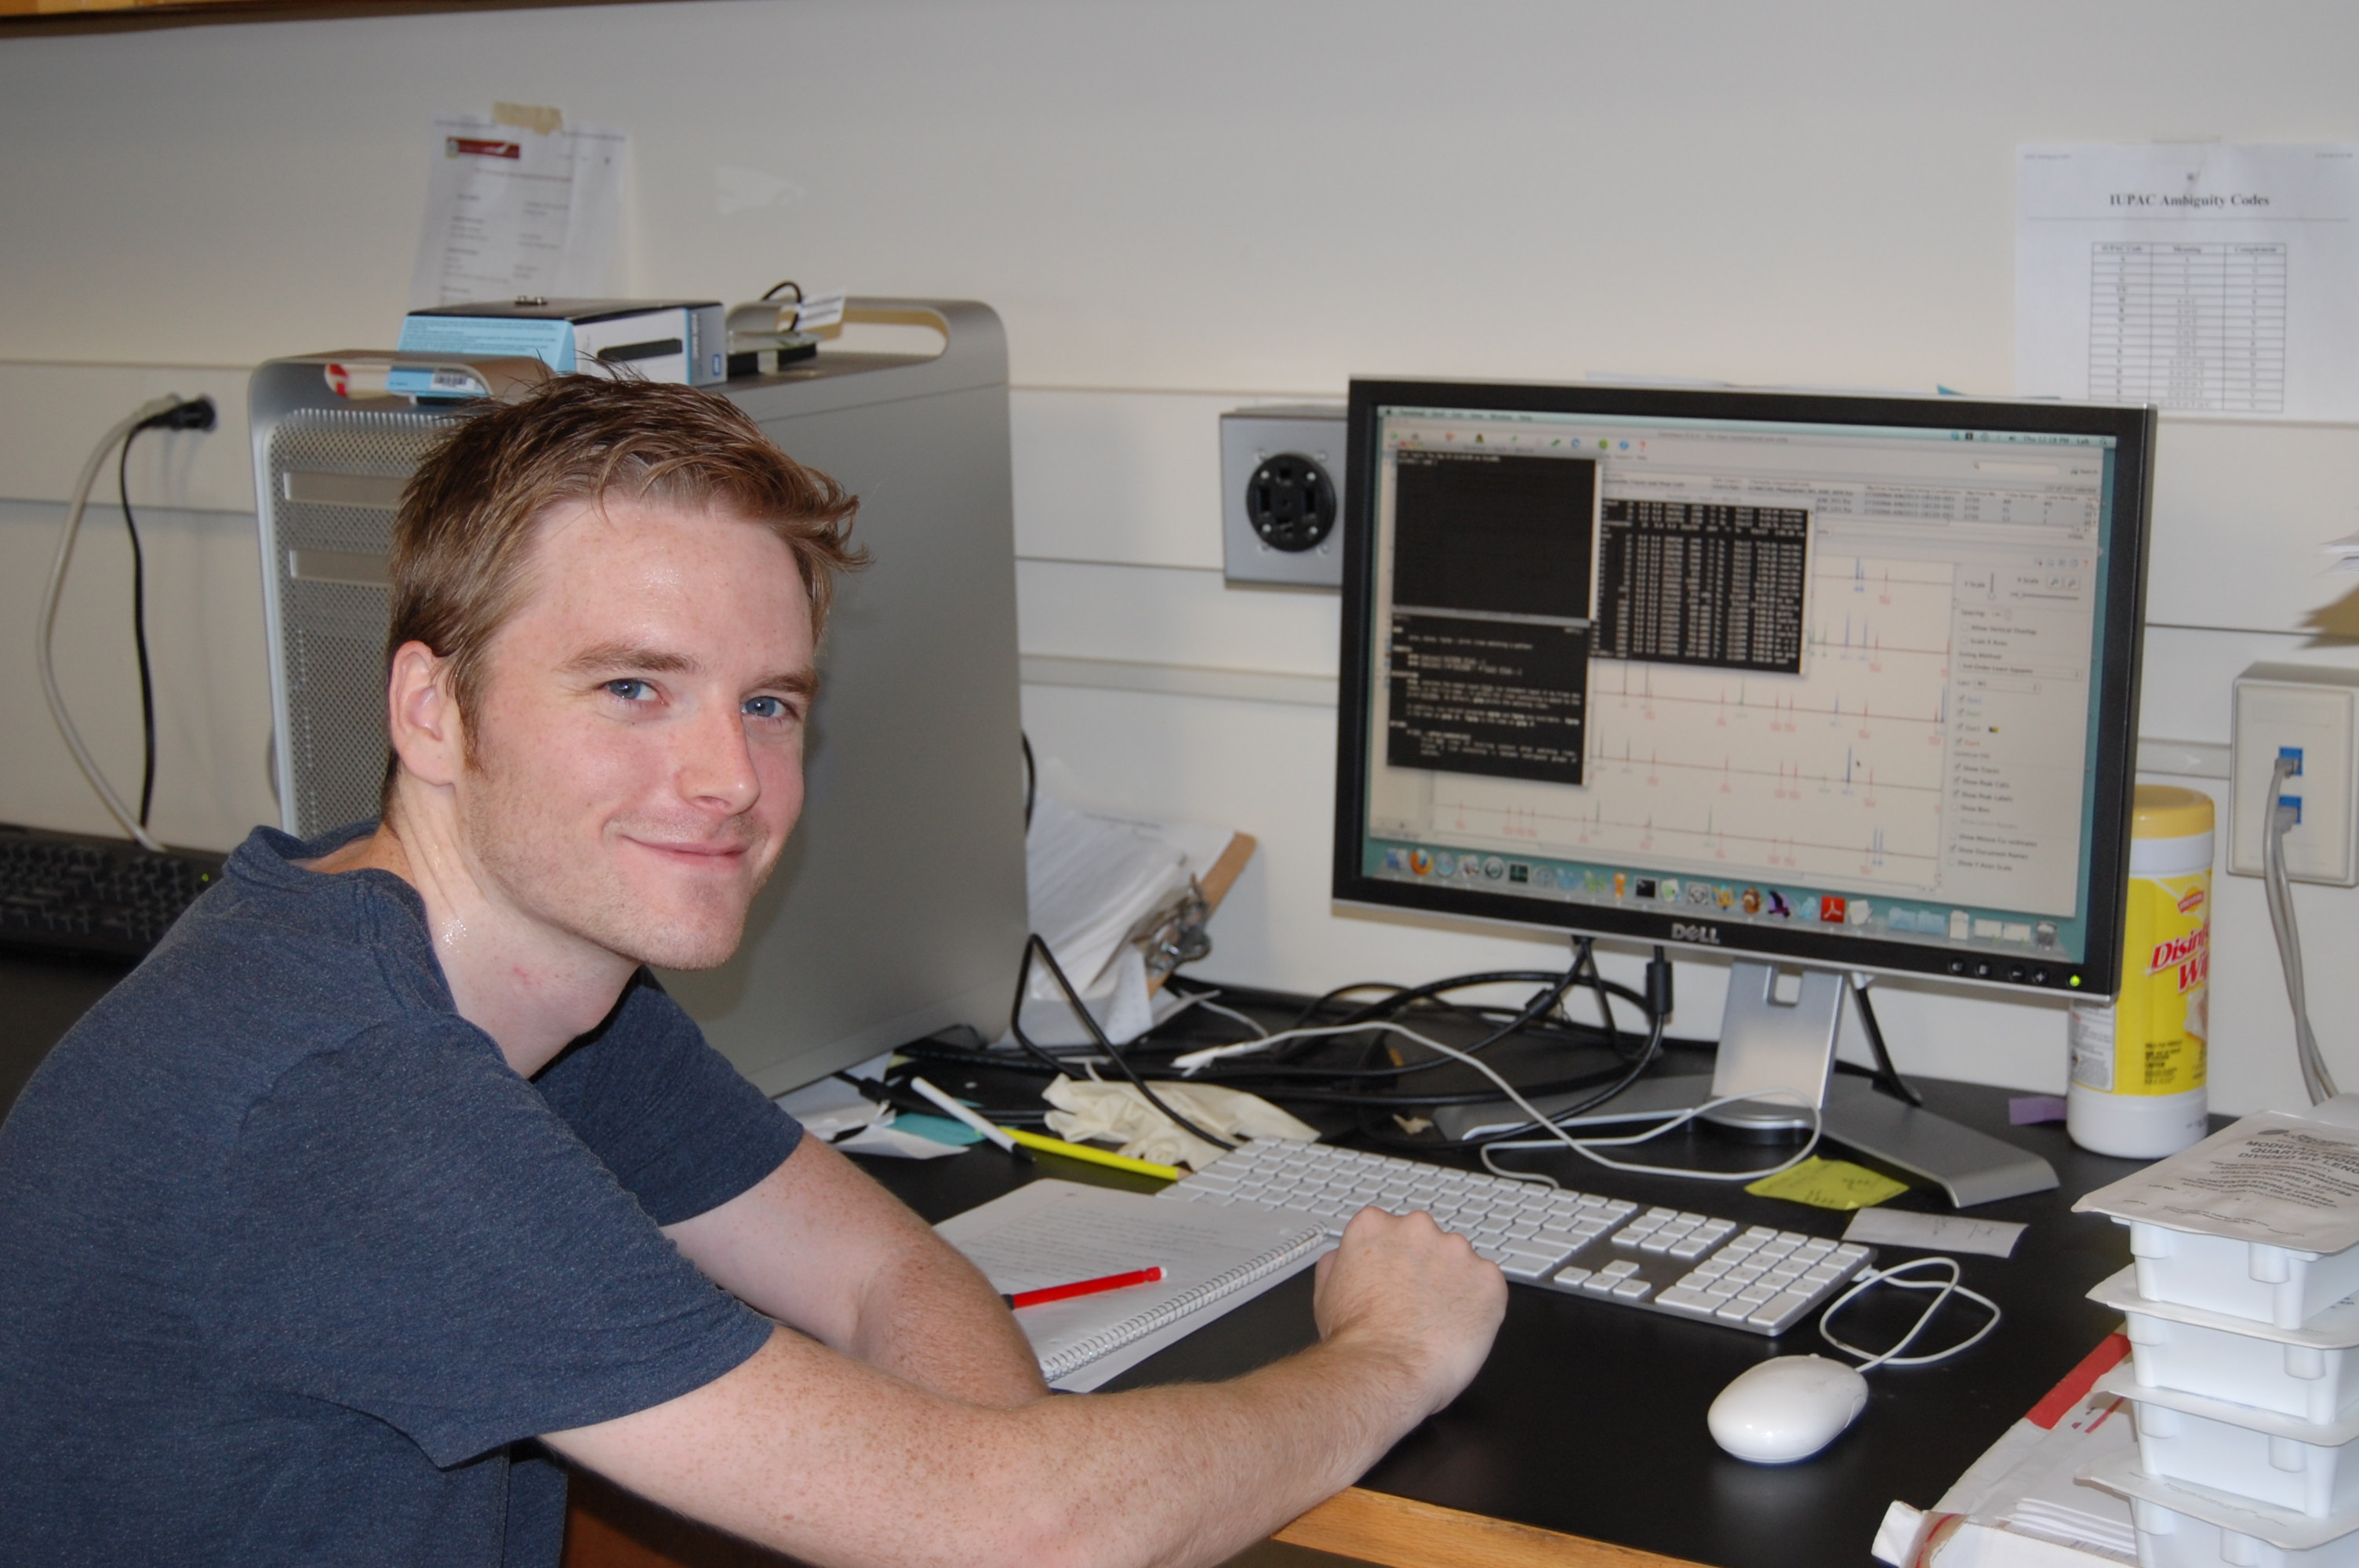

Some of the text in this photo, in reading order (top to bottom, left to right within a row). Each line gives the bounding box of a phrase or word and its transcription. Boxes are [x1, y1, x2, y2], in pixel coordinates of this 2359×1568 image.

[2109, 194, 2270, 209] IUPAC Ambiguity Codes
[1670, 922, 1721, 945] DELL
[2250, 1148, 2319, 1157] QUARTER
